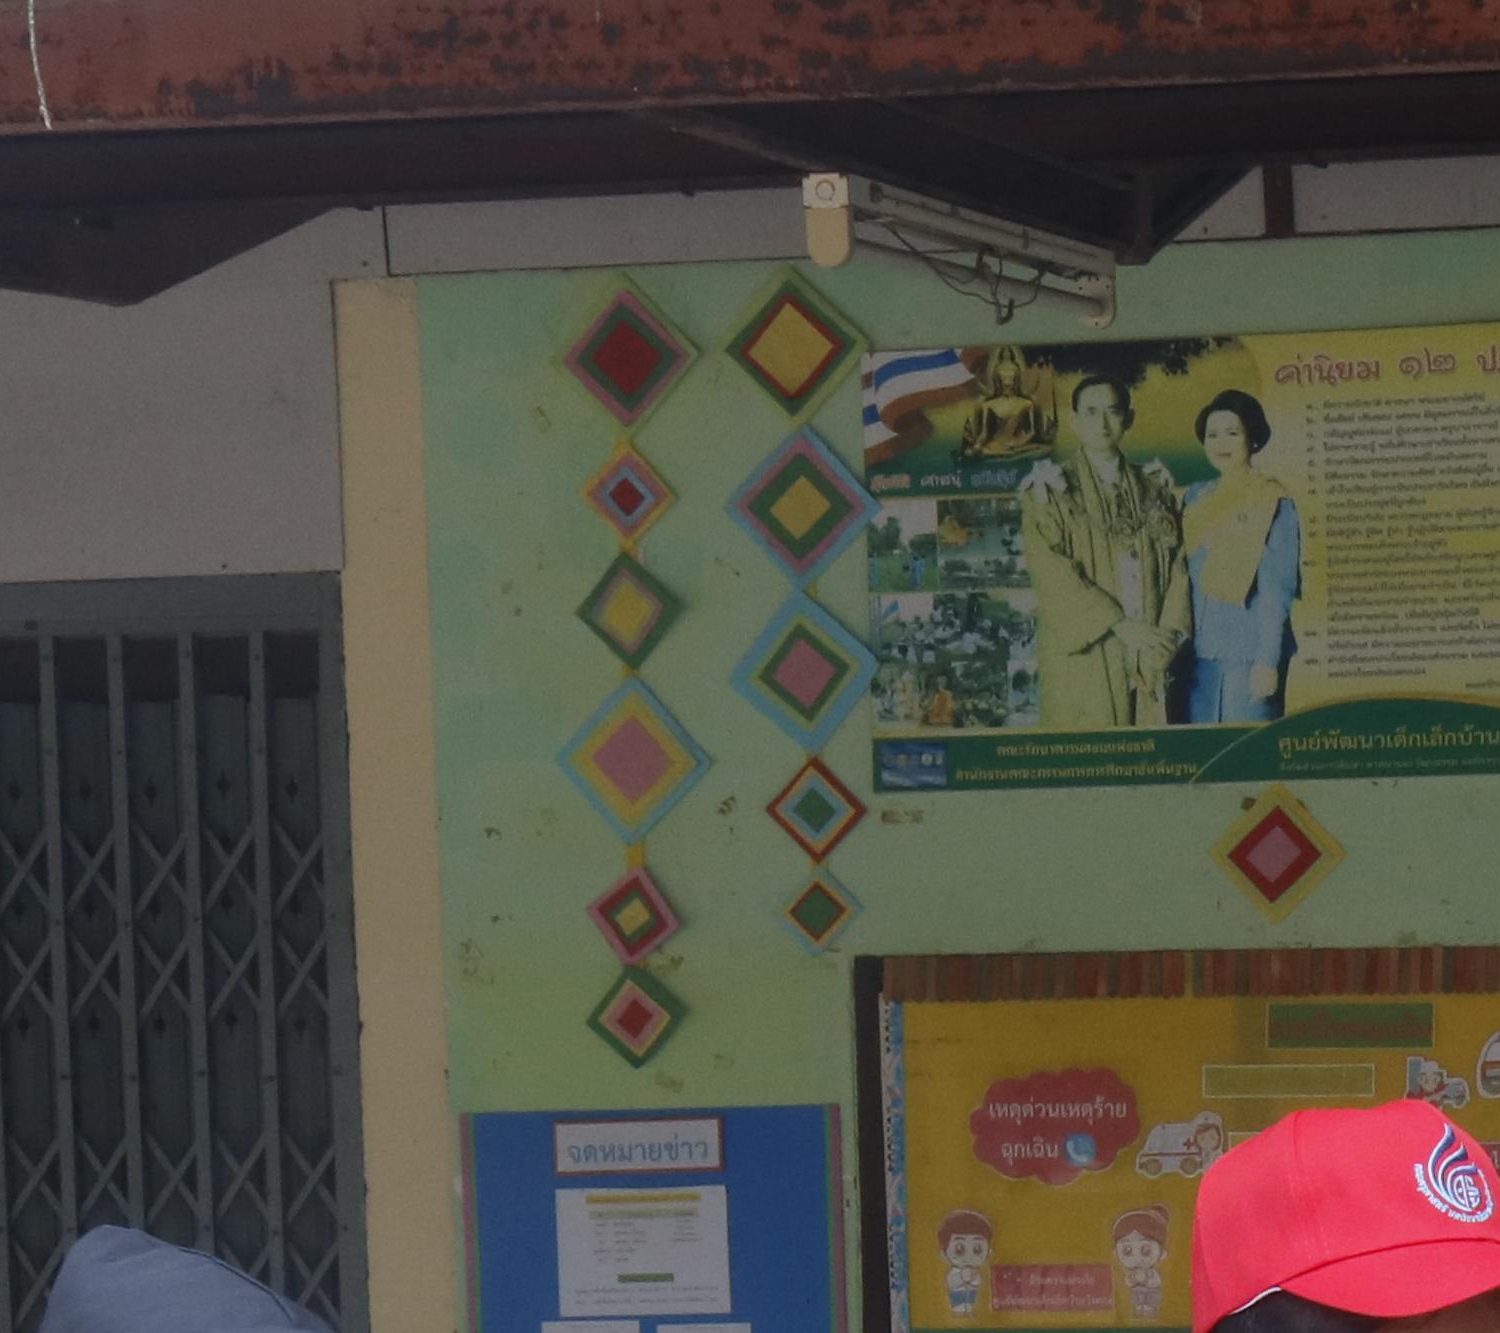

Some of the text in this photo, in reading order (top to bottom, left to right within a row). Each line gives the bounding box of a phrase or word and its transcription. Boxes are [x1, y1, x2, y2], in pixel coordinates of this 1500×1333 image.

[1274, 352, 1381, 386] ค่านิยม
[1399, 348, 1457, 379] ๑๒
[988, 1095, 1127, 1126] เหตุด่วนเหตุร้าย
[567, 1132, 709, 1164] จดหมายข่าว
[1001, 1135, 1059, 1166] ฉุกเฉิน
